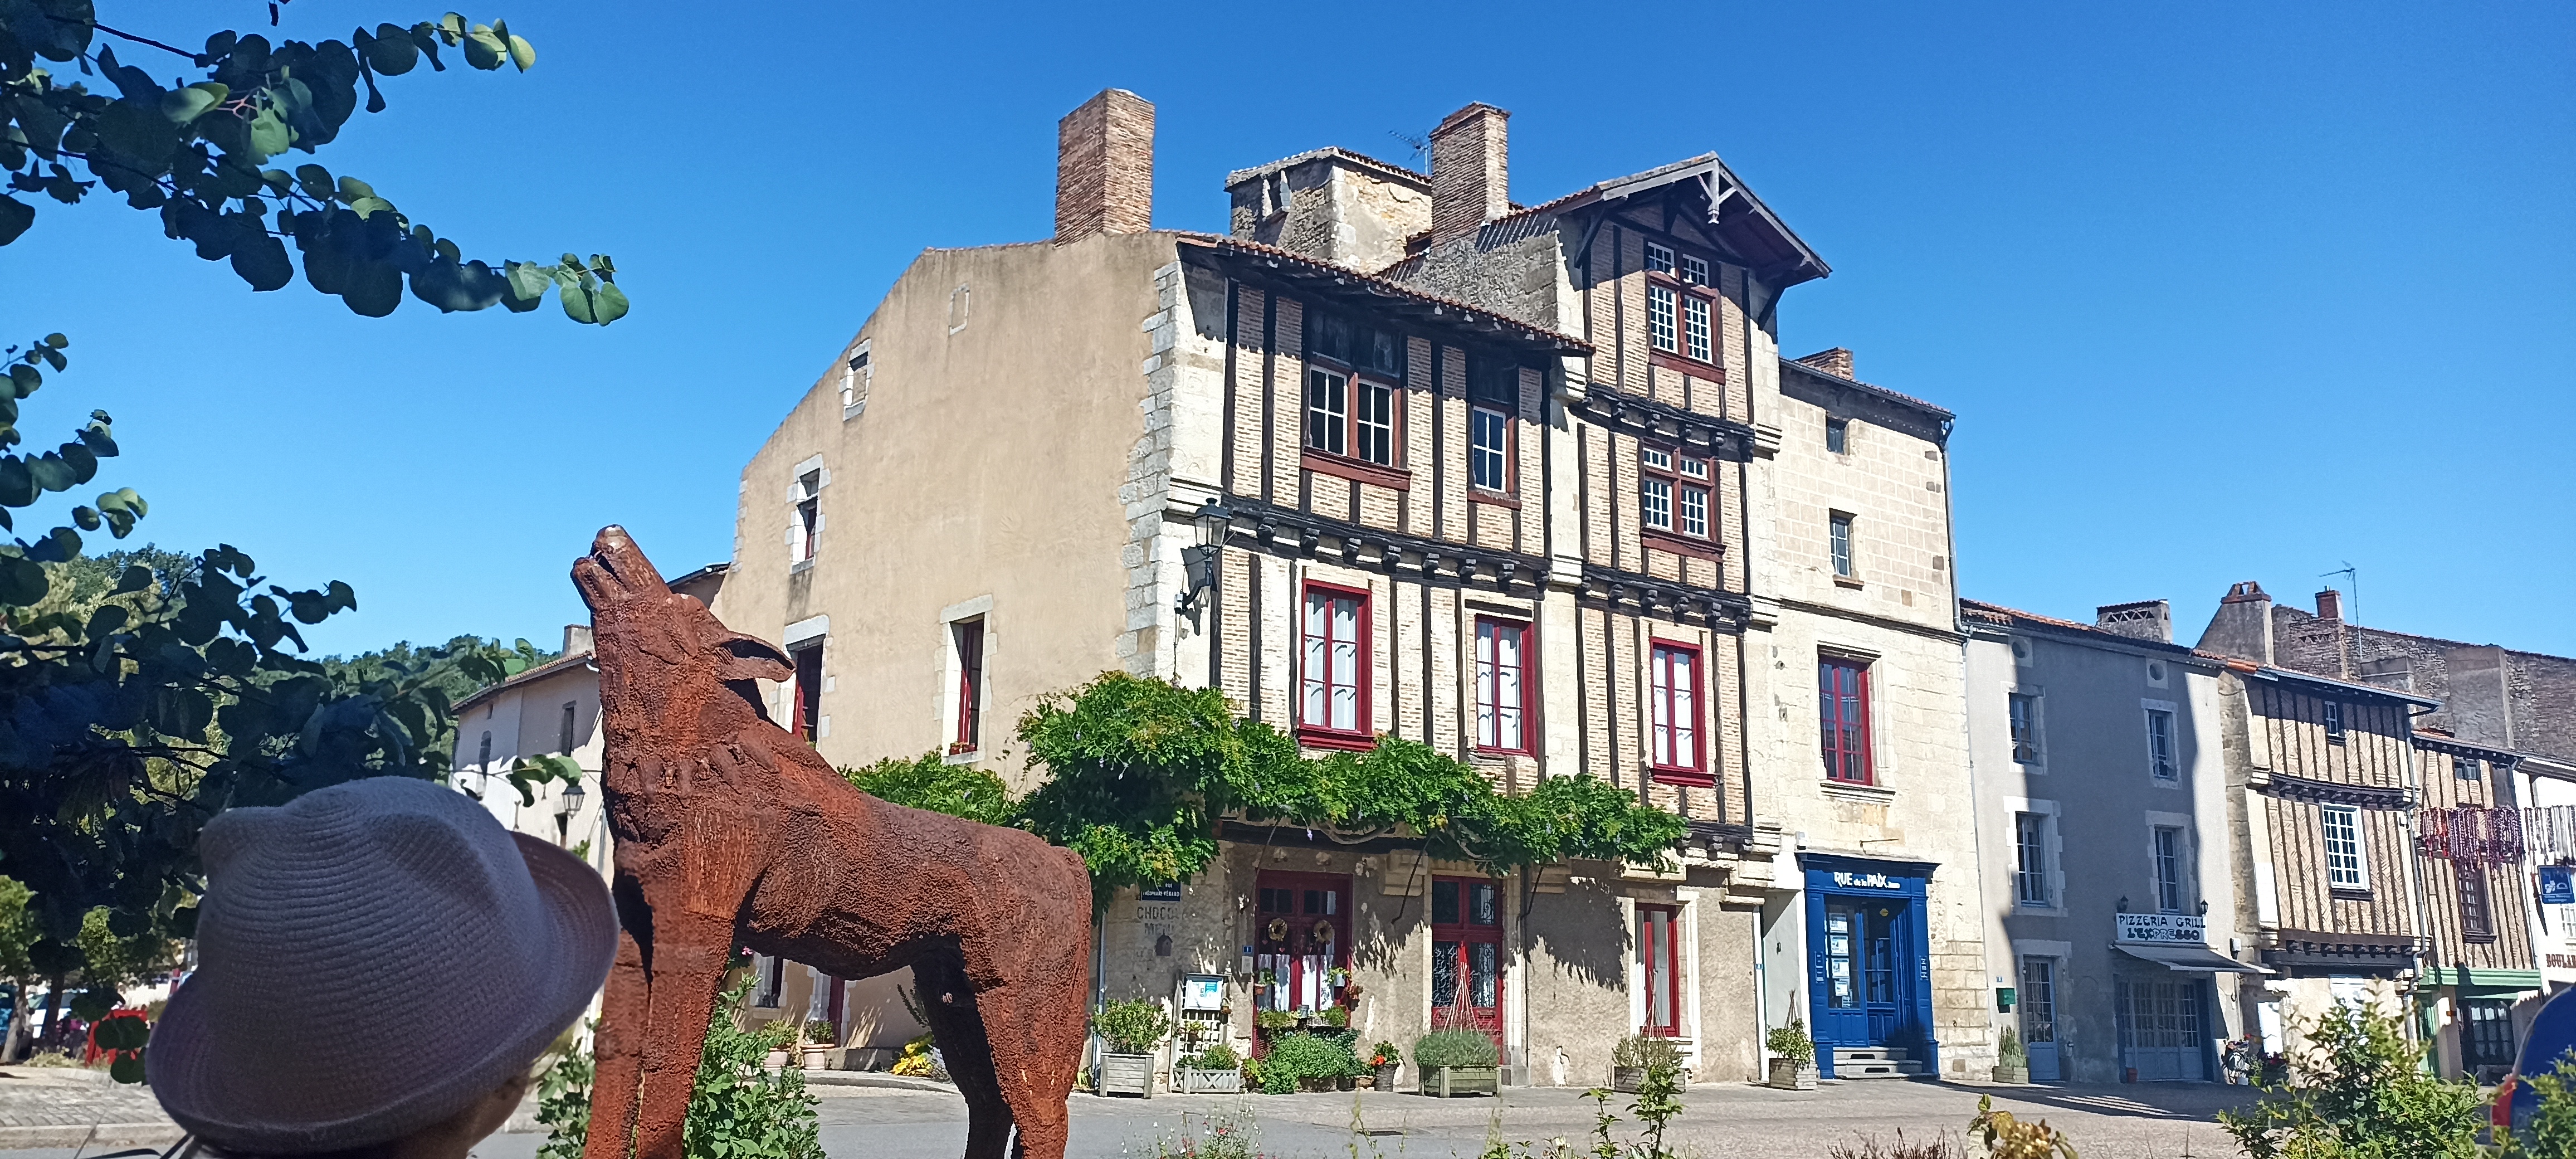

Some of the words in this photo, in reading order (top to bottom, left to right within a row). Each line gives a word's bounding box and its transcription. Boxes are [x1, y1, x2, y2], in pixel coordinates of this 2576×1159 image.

[1834, 872, 1852, 887] RUE
[1867, 873, 1887, 888] PAIX
[2119, 915, 2168, 927] PIZZERIA
[2176, 917, 2206, 928] GRILL
[2127, 928, 2200, 941] L'EXPRESSO
